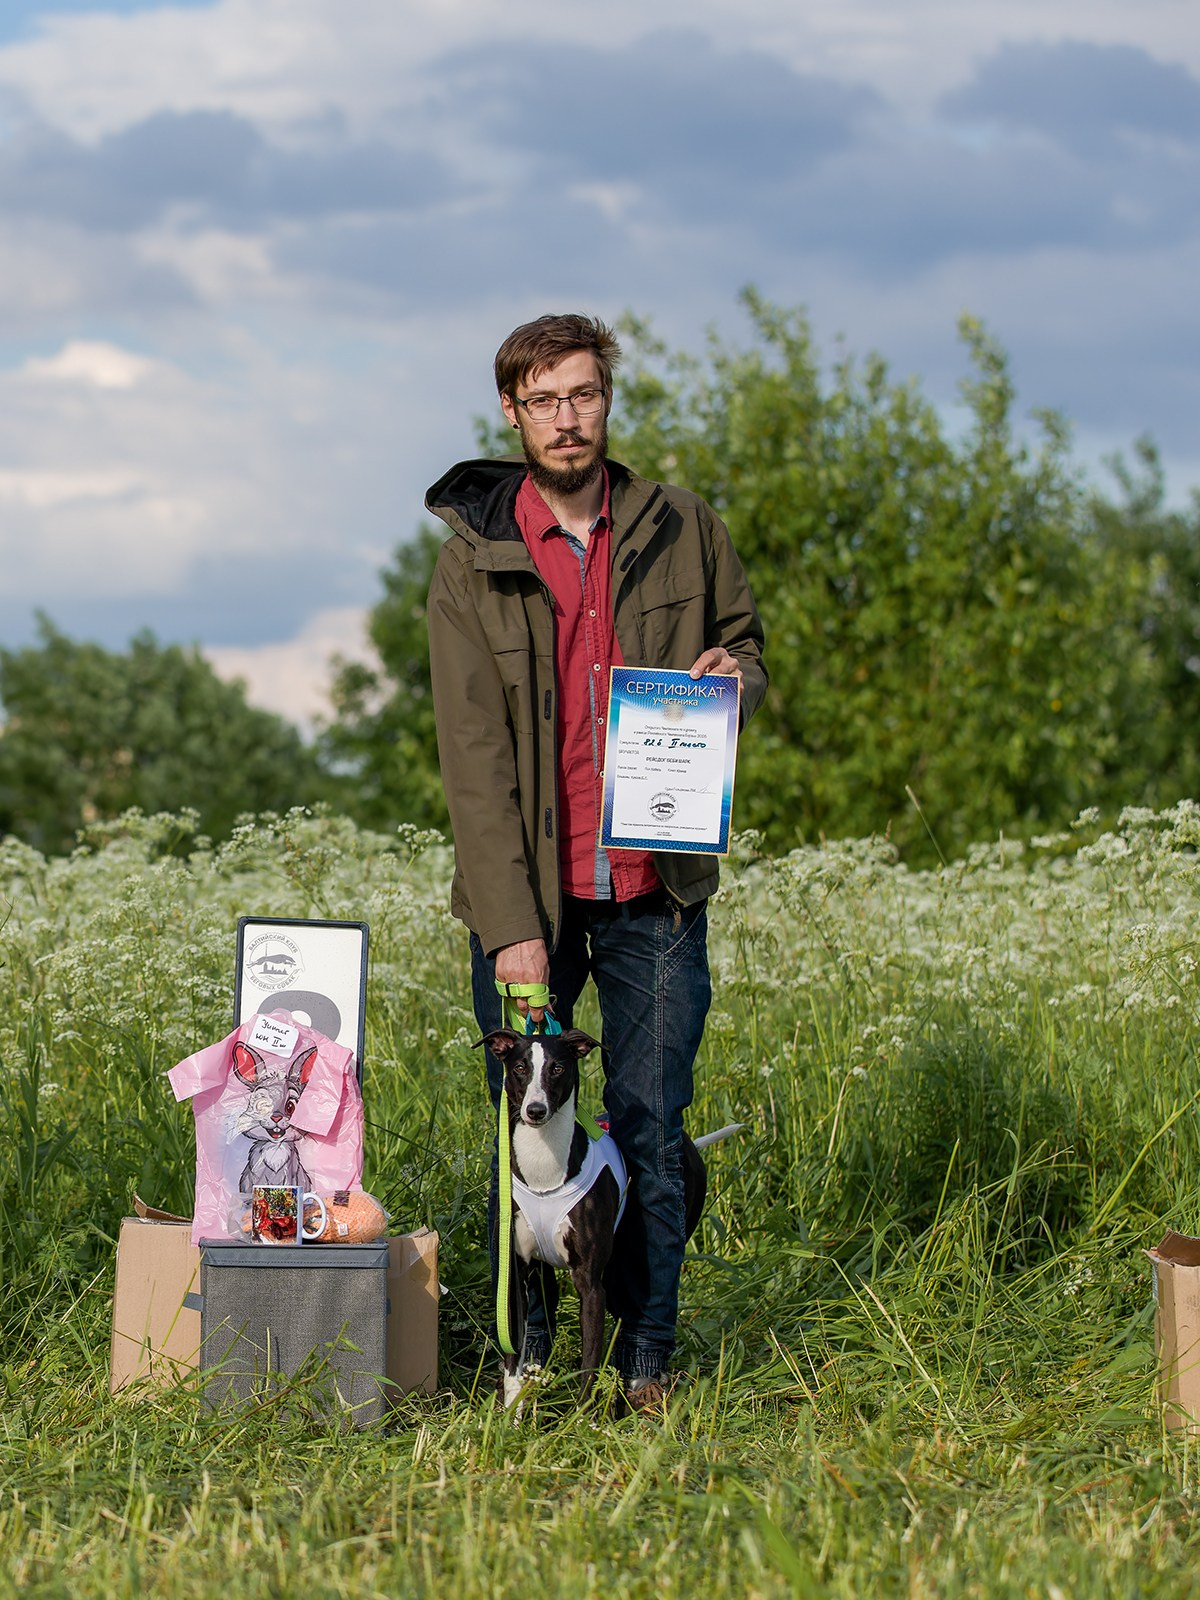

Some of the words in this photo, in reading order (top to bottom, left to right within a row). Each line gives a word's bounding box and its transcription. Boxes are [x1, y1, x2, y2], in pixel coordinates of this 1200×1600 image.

[626, 681, 726, 699] СЕРТИФИКАТ
[652, 697, 699, 707] участника
[248, 933, 286, 951] БАЛТИЙСКИЙ
[285, 939, 298, 953] КЛУБ
[250, 975, 275, 990] БЕГОВЫХ
[276, 975, 296, 990] СОБАК
